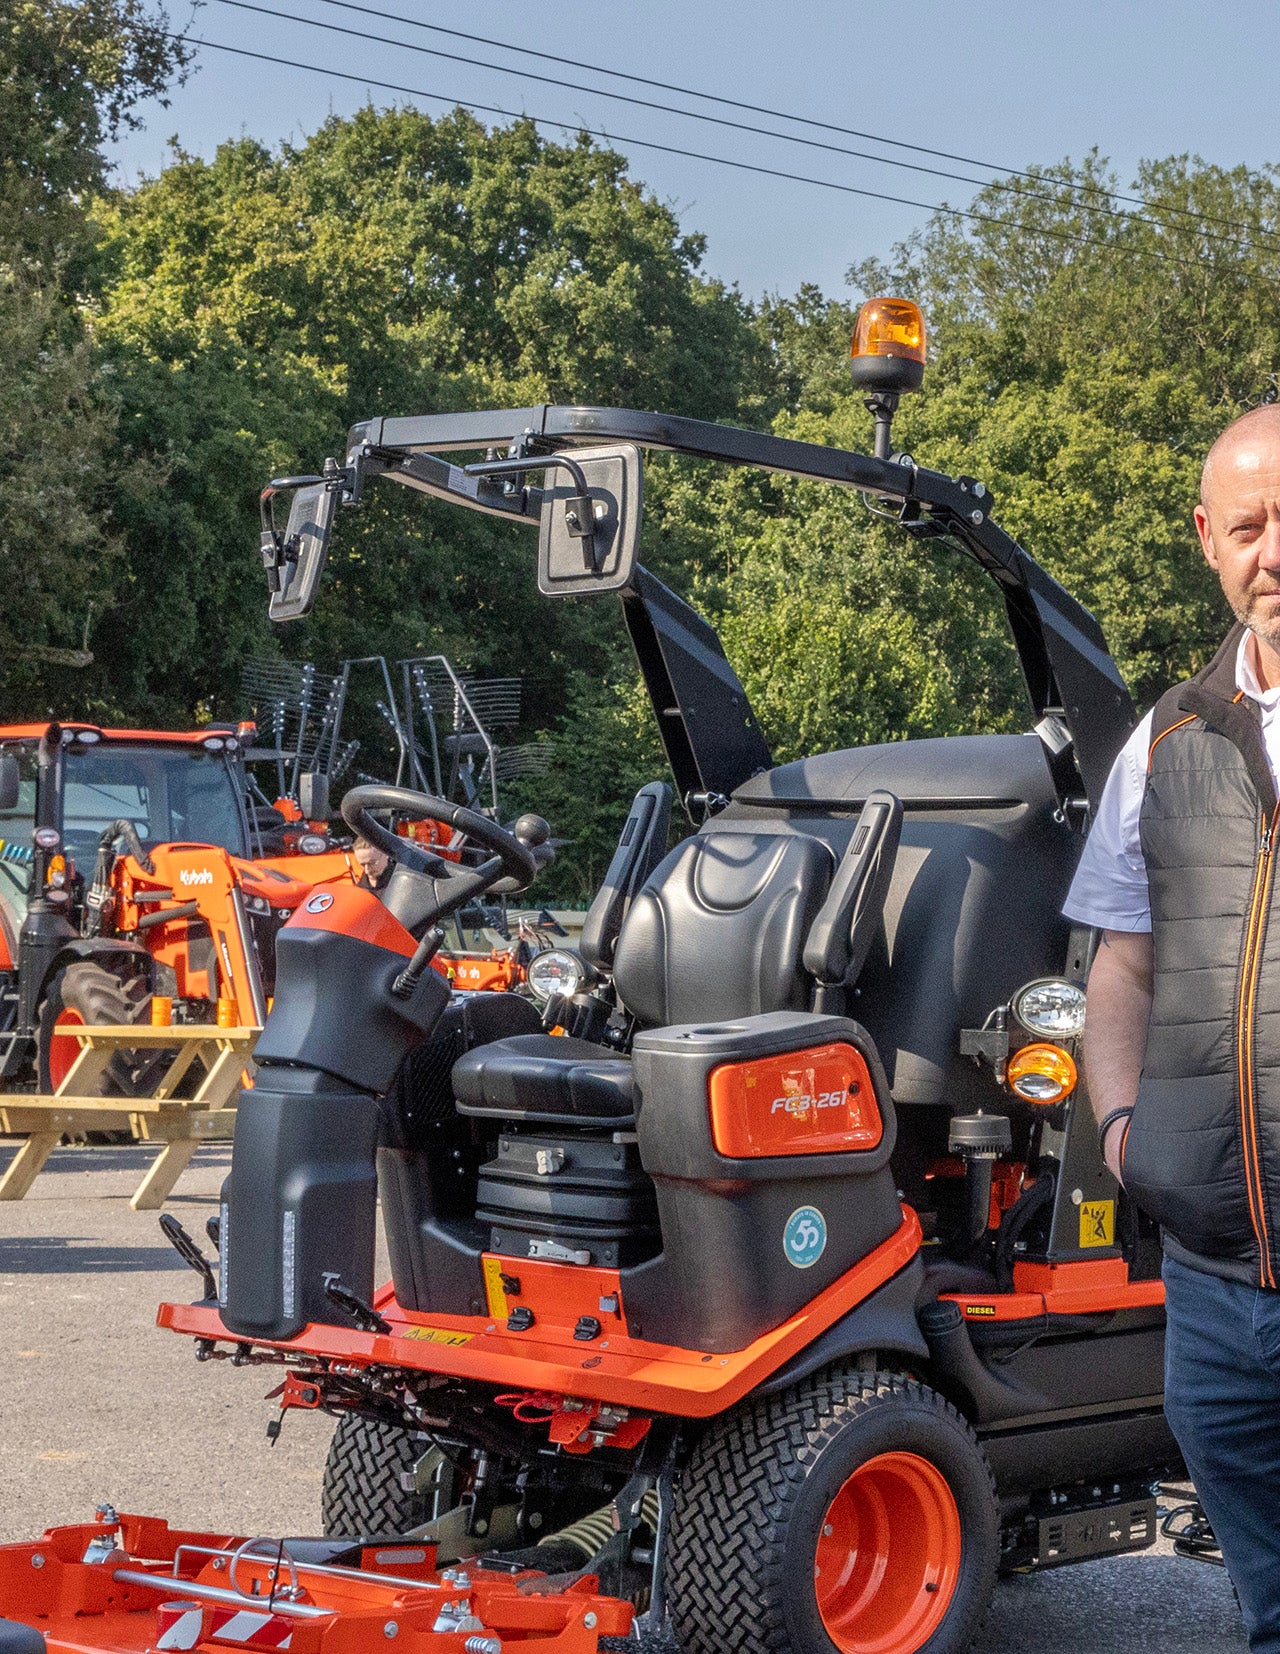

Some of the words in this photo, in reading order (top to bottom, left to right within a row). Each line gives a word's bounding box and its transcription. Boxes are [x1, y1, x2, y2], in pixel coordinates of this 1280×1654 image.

[180, 868, 213, 885] Kubota
[770, 1090, 847, 1114] FC3-261
[967, 1306, 995, 1315] DIESEL
